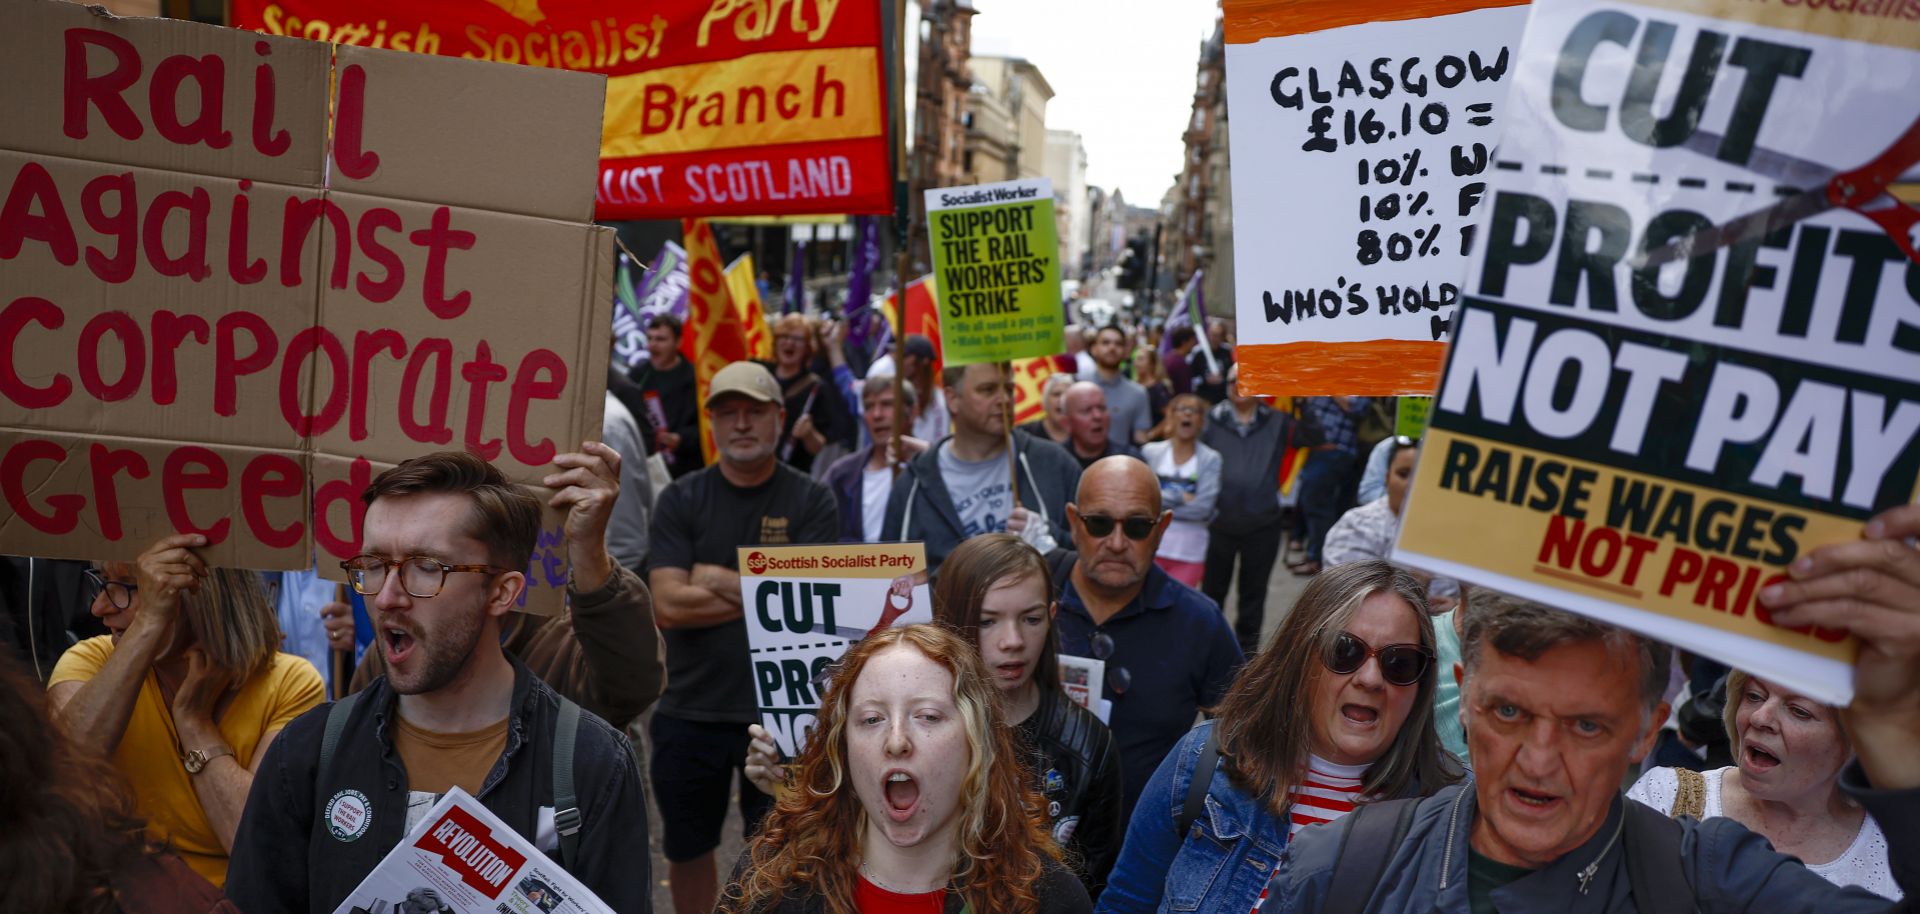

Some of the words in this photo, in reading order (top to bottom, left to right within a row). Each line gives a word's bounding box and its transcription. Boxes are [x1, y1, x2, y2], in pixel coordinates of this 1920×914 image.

[462, 14, 668, 69] Socialist
[697, 0, 838, 47] Party
[641, 65, 845, 135] Branch
[1270, 46, 1509, 111] GLASGOW
[1550, 10, 1813, 167] CUT
[63, 28, 379, 179] Rail
[1302, 102, 1449, 152] £16.10
[685, 156, 852, 203] SCOTLAND
[1358, 148, 1428, 186] 10%
[941, 191, 993, 207] Socialist
[994, 187, 1038, 202] Worker
[1359, 191, 1434, 223] 10%
[0, 162, 475, 319] Against
[940, 206, 1035, 239] SUPPORT
[1357, 223, 1441, 265] 80%
[942, 239, 981, 265] THE
[988, 233, 1034, 262] RAIL
[944, 257, 1049, 292] WORKERS'
[949, 288, 1020, 318] STRIKE
[1262, 276, 1369, 325] WHO'S
[0, 297, 567, 466] Corporate
[1439, 307, 1690, 457] NOT
[1685, 361, 1920, 512] PAY
[0, 440, 372, 561] Greed
[1439, 440, 1599, 517] RAISE
[1604, 477, 1808, 567] WAGES
[768, 556, 818, 569] Scottish
[822, 554, 876, 568] Socialist
[879, 554, 915, 569] Party
[1538, 516, 1659, 587] NOT
[755, 580, 841, 635] CUT
[334, 814, 355, 831] WORKERS
[338, 807, 346, 816] THE
[341, 801, 364, 817] SUPPORT
[432, 818, 514, 887] REVOLUTION
